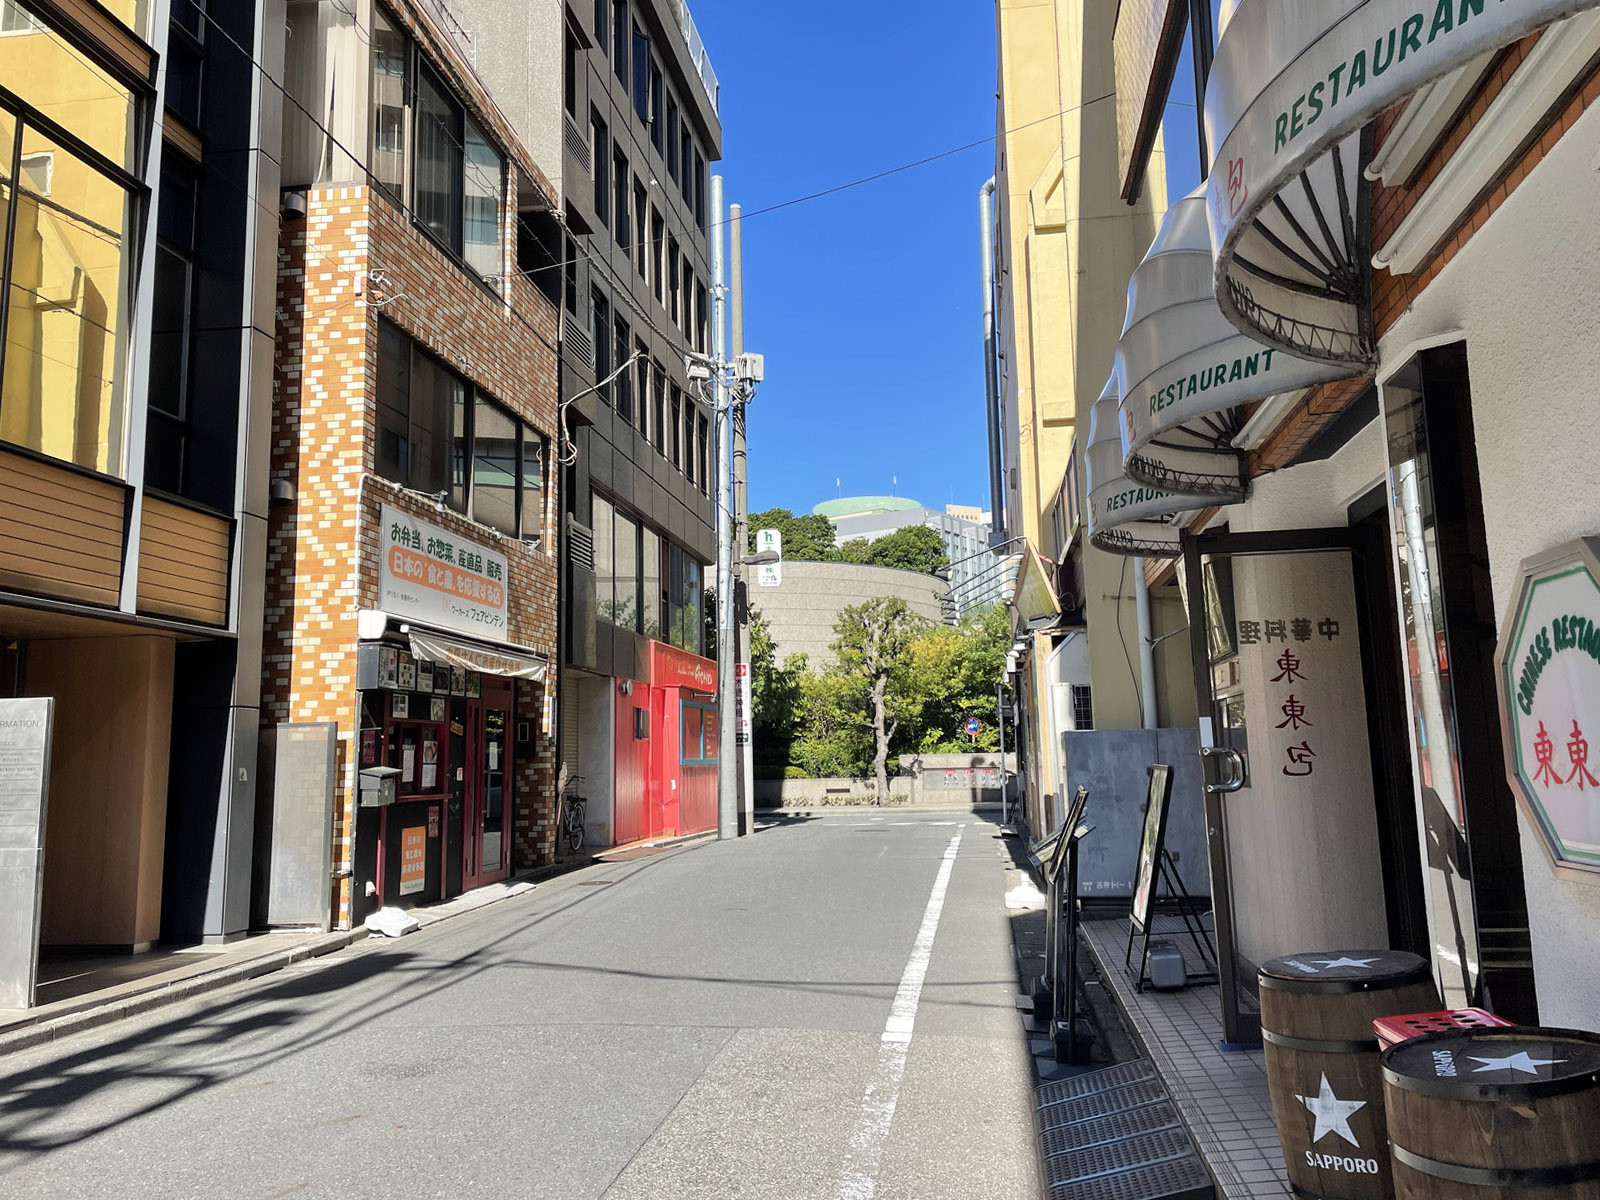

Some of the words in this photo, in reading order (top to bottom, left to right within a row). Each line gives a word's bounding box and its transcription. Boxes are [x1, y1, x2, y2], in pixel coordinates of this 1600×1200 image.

[1273, 0, 1505, 154] RESTAURAN
[1149, 349, 1276, 416] RESTAURANT
[1517, 626, 1552, 716] CHINESE
[1552, 614, 1600, 664] RESTAU
[1532, 719, 1600, 791] 東東
[1305, 1150, 1379, 1174] SAPPORO
